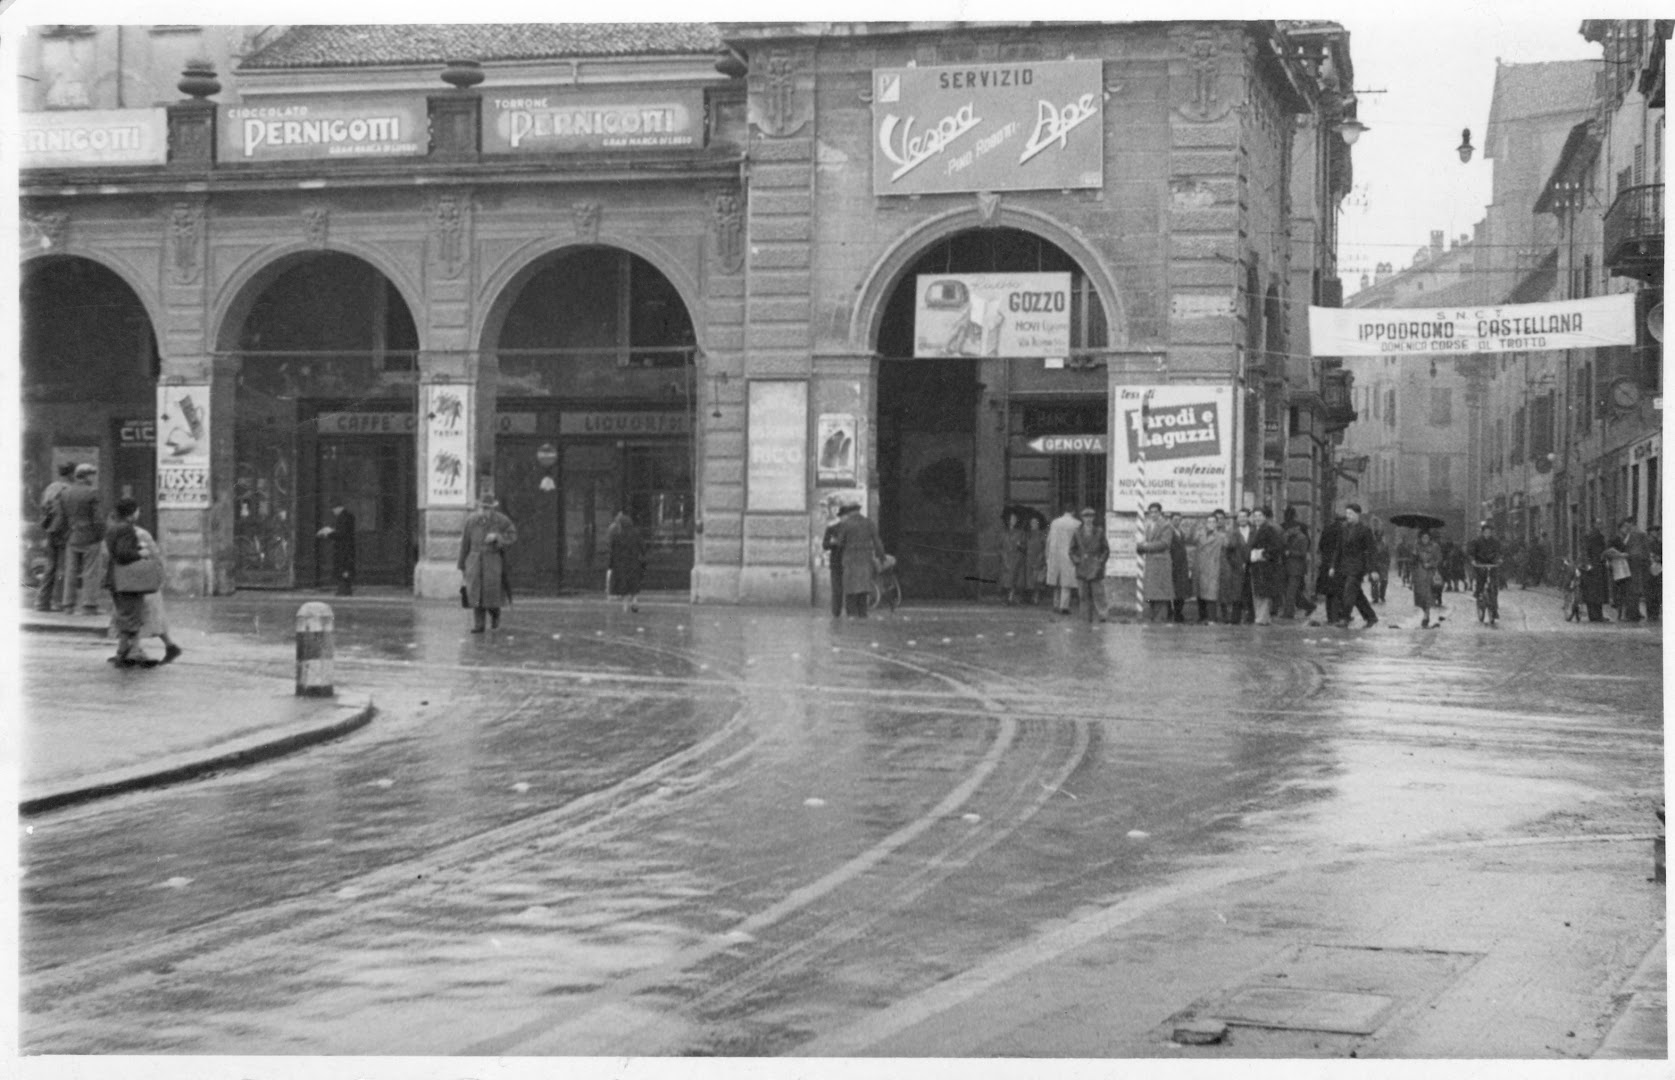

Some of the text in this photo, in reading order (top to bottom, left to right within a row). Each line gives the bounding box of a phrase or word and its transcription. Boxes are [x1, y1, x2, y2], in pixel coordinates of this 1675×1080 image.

[939, 68, 1034, 89] SERVIZIO
[227, 106, 308, 119] CIOCCOLATO
[244, 117, 399, 156] PERNIGOTTI
[509, 109, 675, 148] PERNIGOTTI
[1020, 93, 1098, 165] Ape
[879, 102, 982, 182] Vespa
[1009, 291, 1065, 313] GOZZO
[1015, 320, 1040, 331] NOVI
[1359, 312, 1583, 341] IPPODROMO CASTELLANA
[1431, 339, 1469, 351] CORSE
[1499, 337, 1547, 349] TROTTO
[1201, 410, 1214, 423] e
[1045, 437, 1103, 450] GENOVA
[1138, 423, 1216, 449] Laguzzi
[1173, 463, 1226, 476] confezioni
[1119, 479, 1139, 488] NOV
